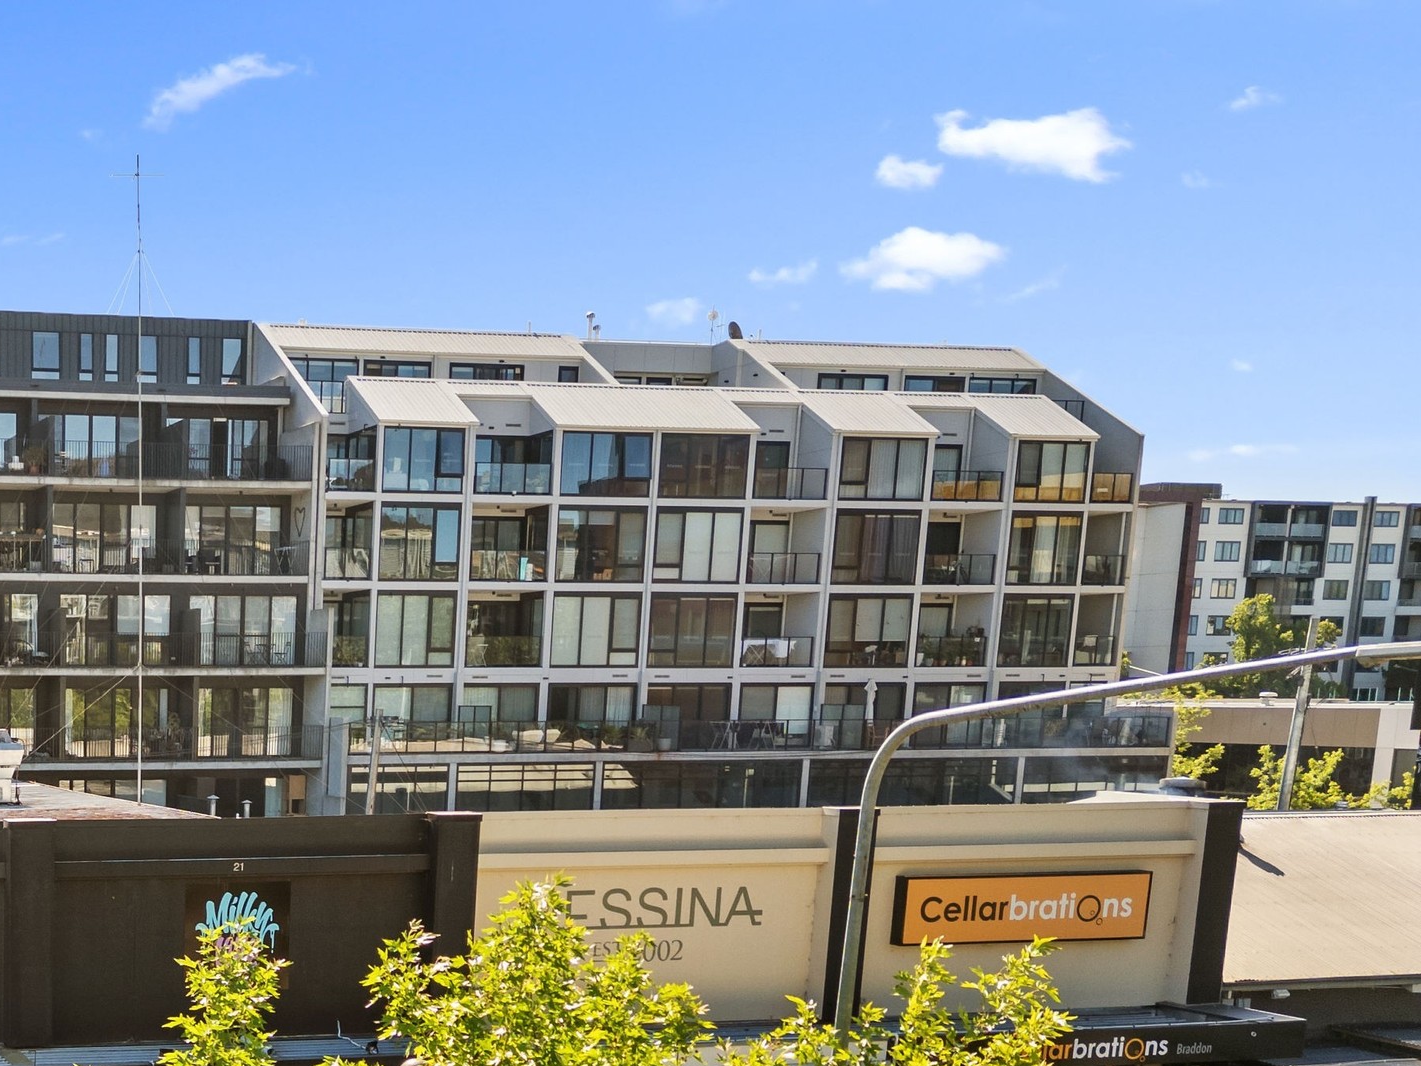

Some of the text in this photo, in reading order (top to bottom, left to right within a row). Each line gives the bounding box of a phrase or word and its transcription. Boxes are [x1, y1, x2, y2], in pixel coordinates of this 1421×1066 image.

[233, 863, 244, 872] 21
[564, 886, 763, 929] ESSINA
[1176, 1043, 1213, 1055] Braddon
